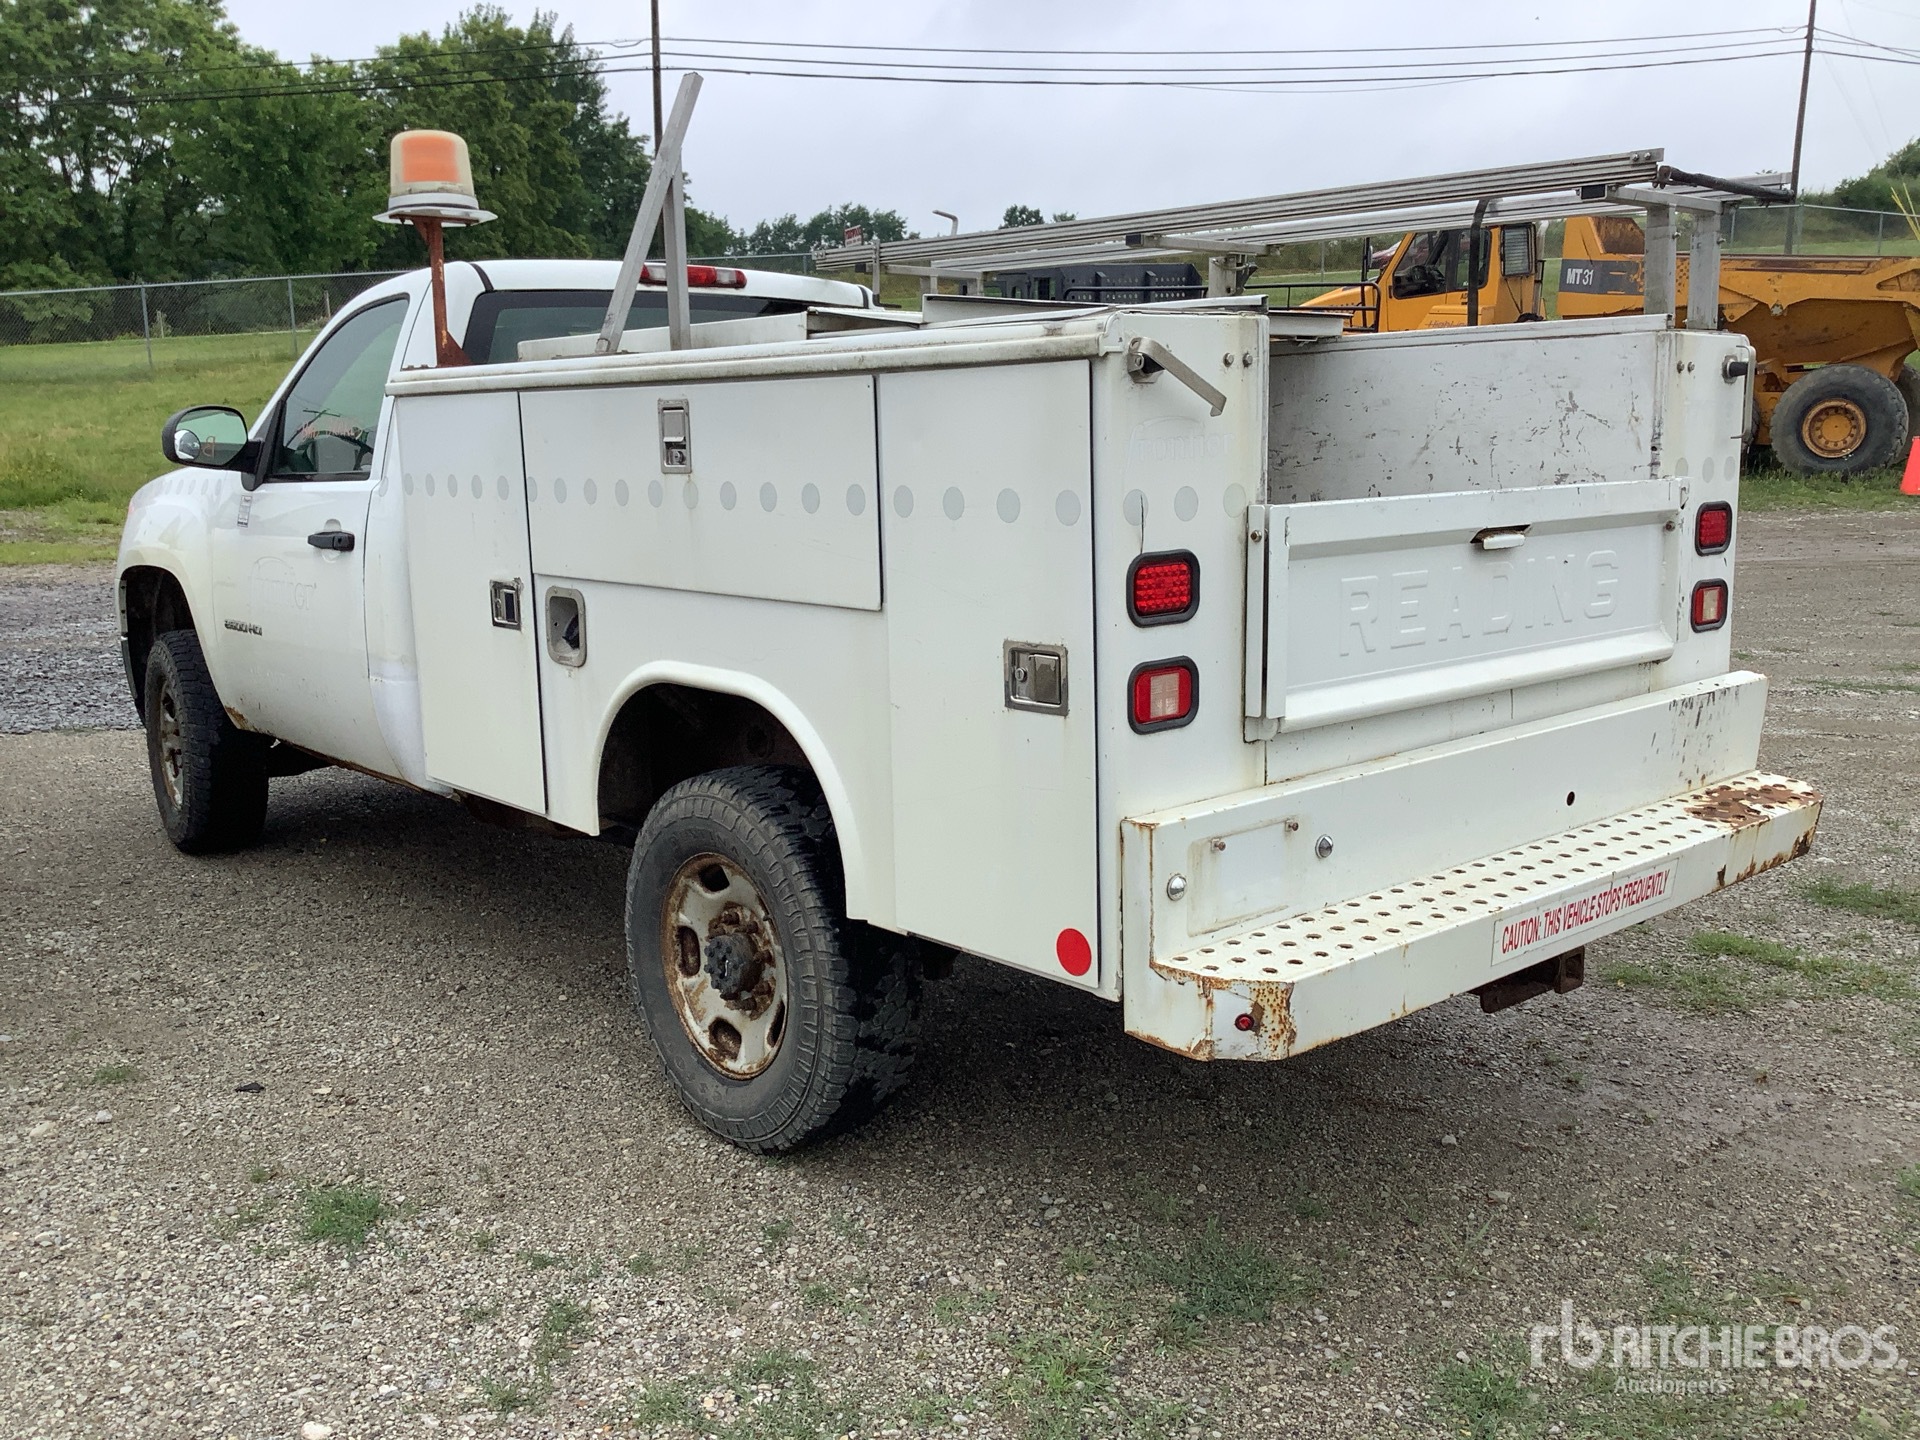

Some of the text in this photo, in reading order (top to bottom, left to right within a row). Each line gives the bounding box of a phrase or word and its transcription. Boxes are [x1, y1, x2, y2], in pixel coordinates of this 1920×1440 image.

[1339, 550, 1619, 657] READING
[1502, 869, 1670, 954] CAUTION: THIS VEHICLE STOPS FREQUENTLY
